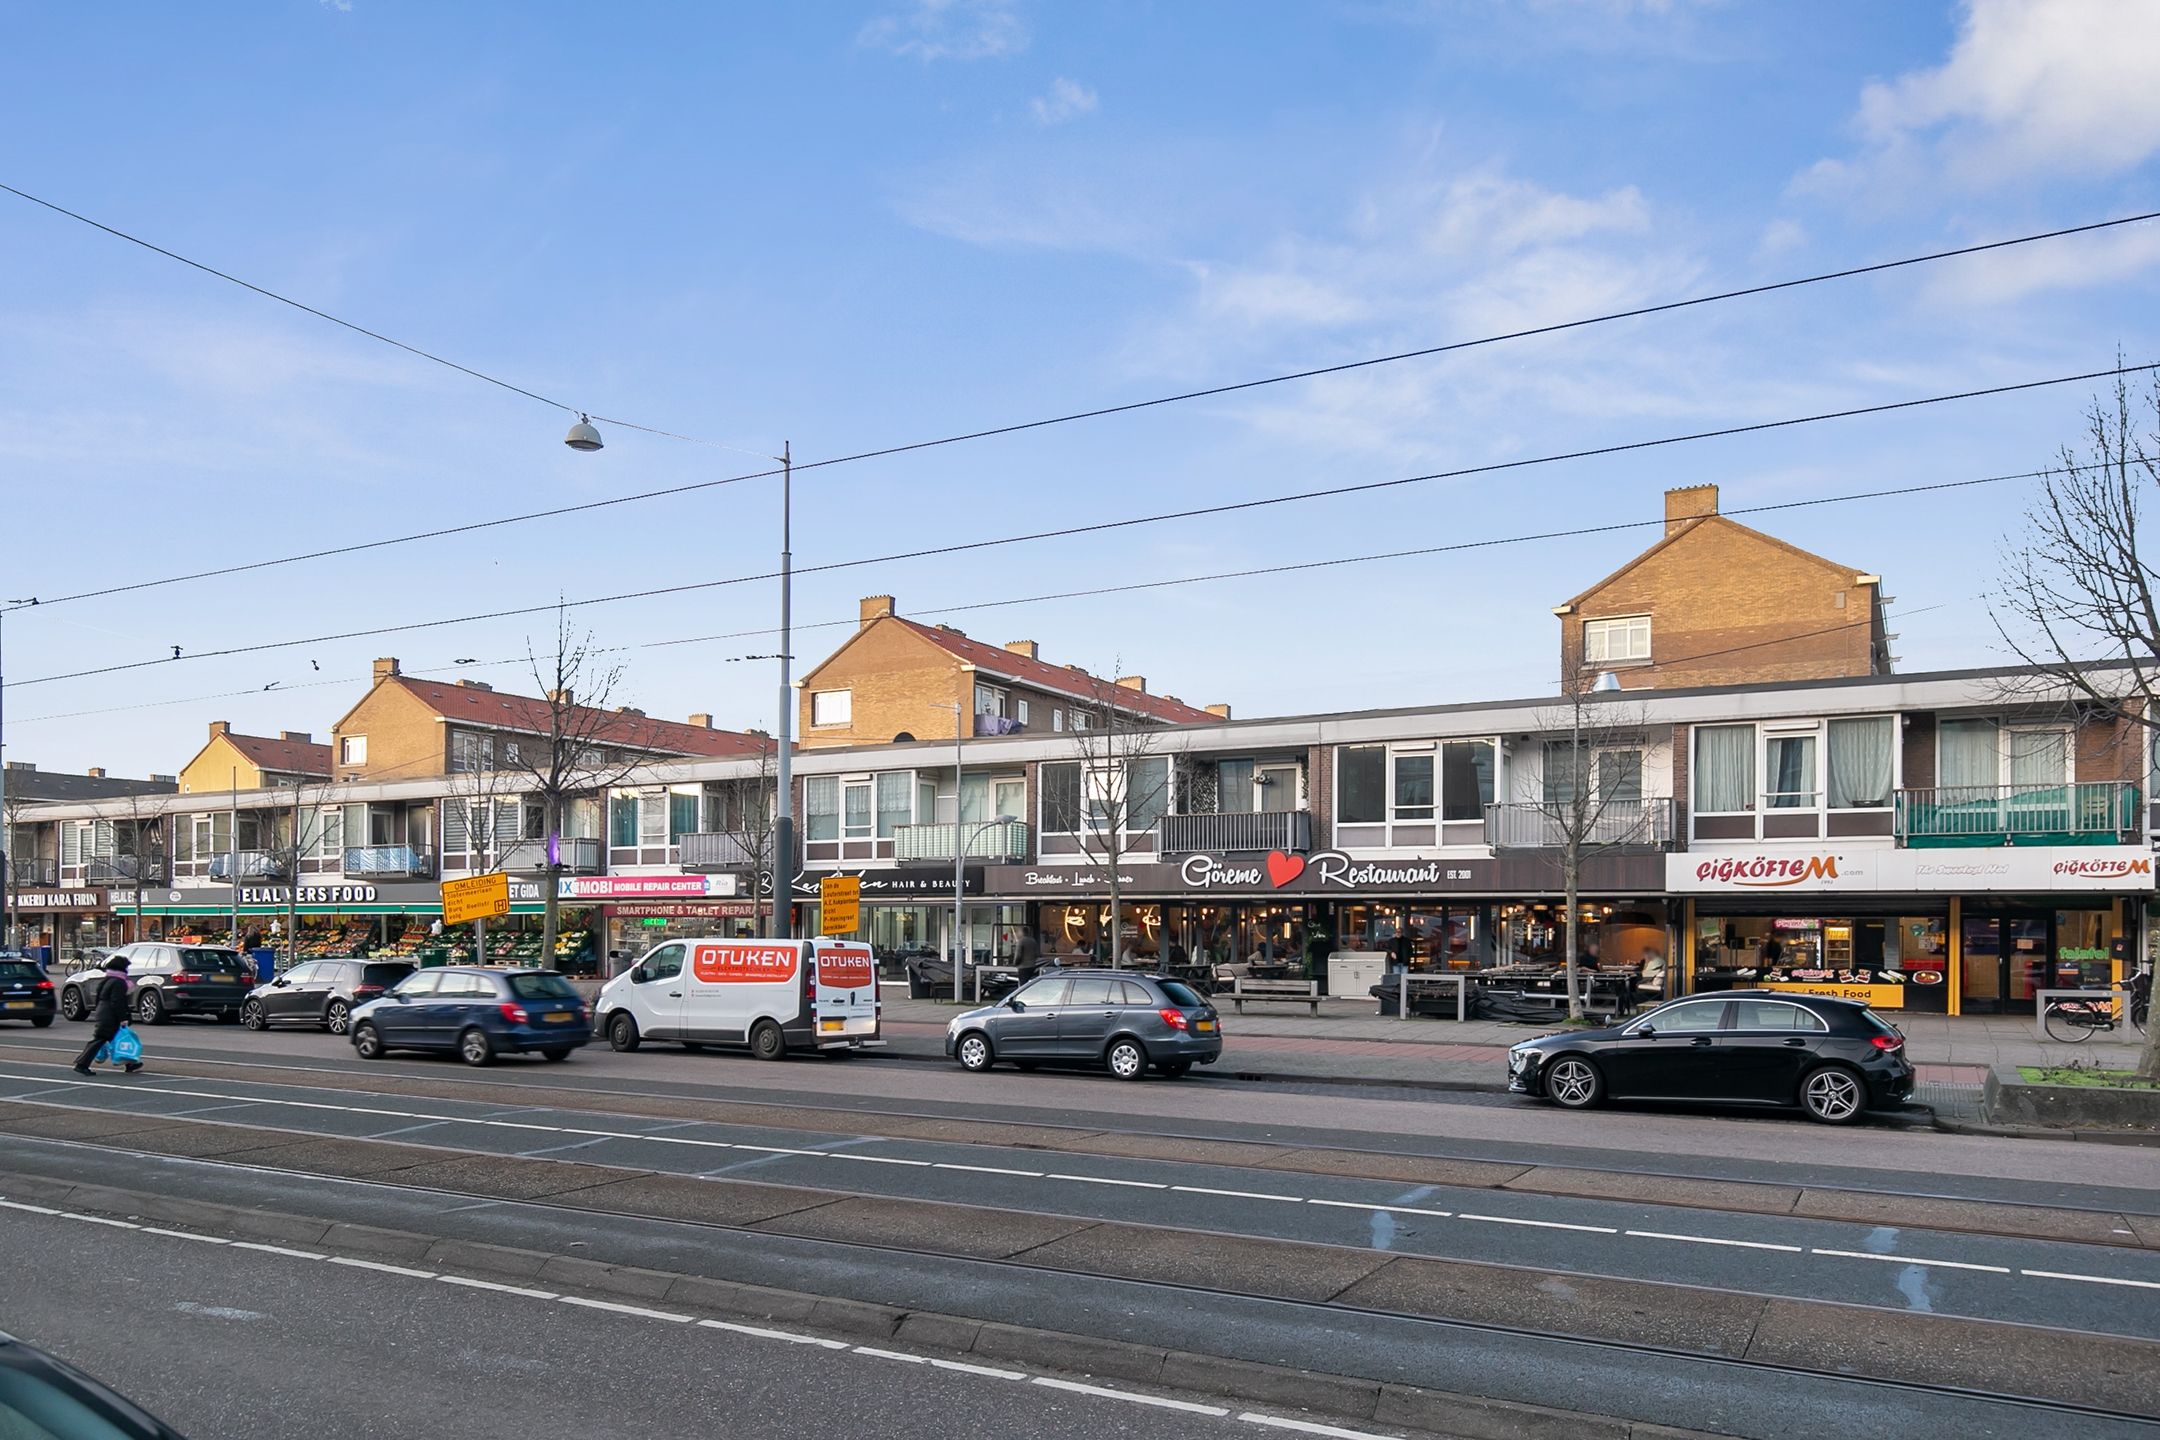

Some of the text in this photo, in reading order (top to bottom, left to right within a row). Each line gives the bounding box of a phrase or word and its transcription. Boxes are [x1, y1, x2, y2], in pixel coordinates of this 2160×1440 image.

[1181, 854, 1263, 888] Göreme
[1308, 852, 1440, 888] Restaurant
[455, 877, 496, 890] OMLEIDING
[613, 882, 642, 892] MOBILE
[643, 882, 670, 891] REPAIR
[671, 881, 701, 891] CENTER
[892, 880, 970, 889] HAIR & BEAUY
[332, 886, 376, 901] FOOD
[520, 884, 540, 898] GIDA
[47, 894, 71, 906] KARA
[616, 905, 773, 916] SMARTPHONE & TABLET REPARAIE
[702, 949, 791, 967] OTUKEN
[2059, 946, 2110, 960] falafel
[820, 956, 870, 968] OTUKEN
[1844, 989, 1871, 998] Food
